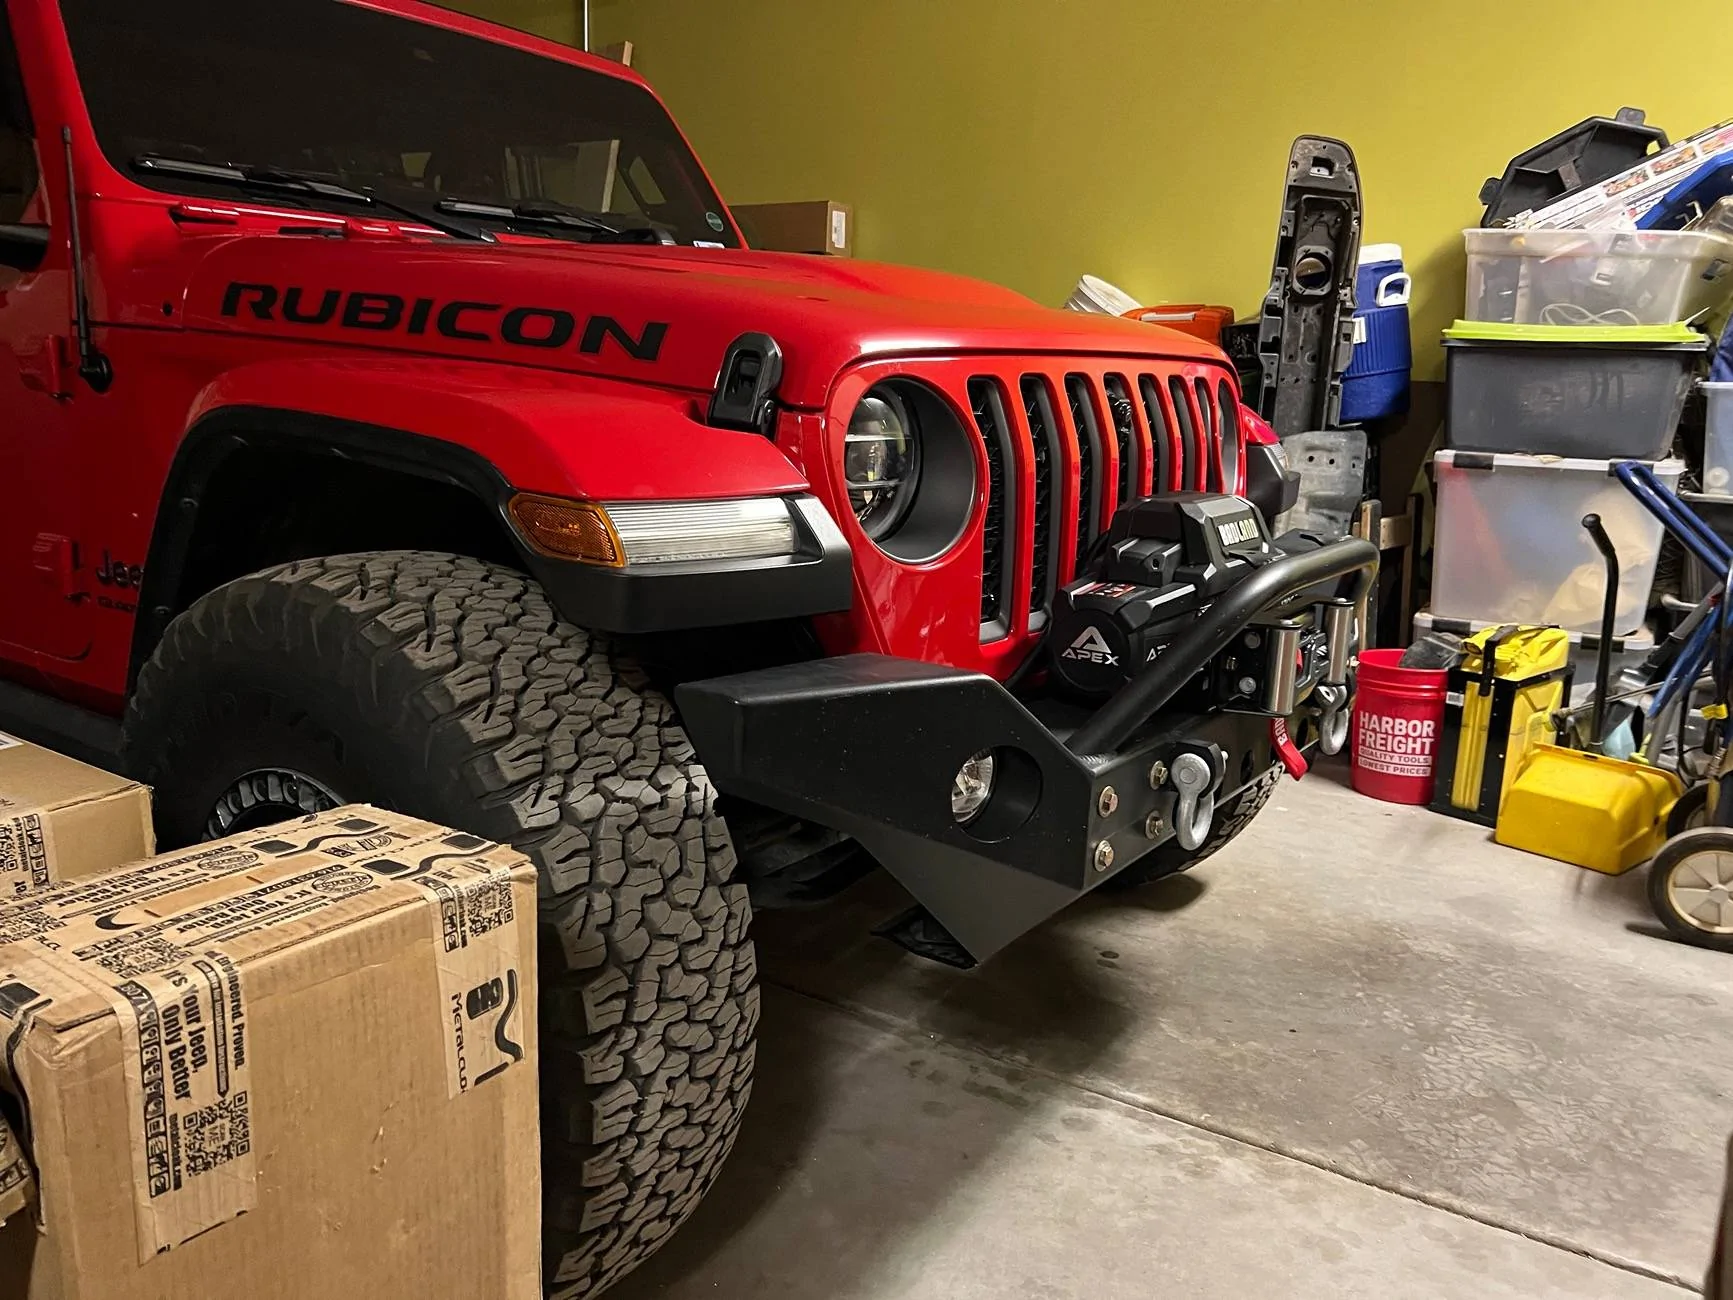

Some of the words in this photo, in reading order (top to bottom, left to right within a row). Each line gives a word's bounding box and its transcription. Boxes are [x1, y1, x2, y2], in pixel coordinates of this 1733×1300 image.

[220, 280, 670, 361] RUBICON
[1217, 518, 1260, 547] BADLAND
[1061, 647, 1120, 667] APEX
[1145, 642, 1172, 663] AP
[1359, 710, 1435, 737] HARBOR
[1359, 728, 1434, 755] FREIGHT
[1359, 747, 1396, 761] QUALITY
[1397, 755, 1430, 765] TOOLS
[1359, 758, 1392, 773] LOWEST
[1392, 765, 1429, 776] PRICES
[161, 969, 188, 987] It's
[181, 984, 201, 1025] Your
[161, 1003, 184, 1046] Only
[188, 1026, 208, 1074] Jeep,
[231, 1022, 245, 1071] Proven.
[168, 1044, 192, 1100] Better
